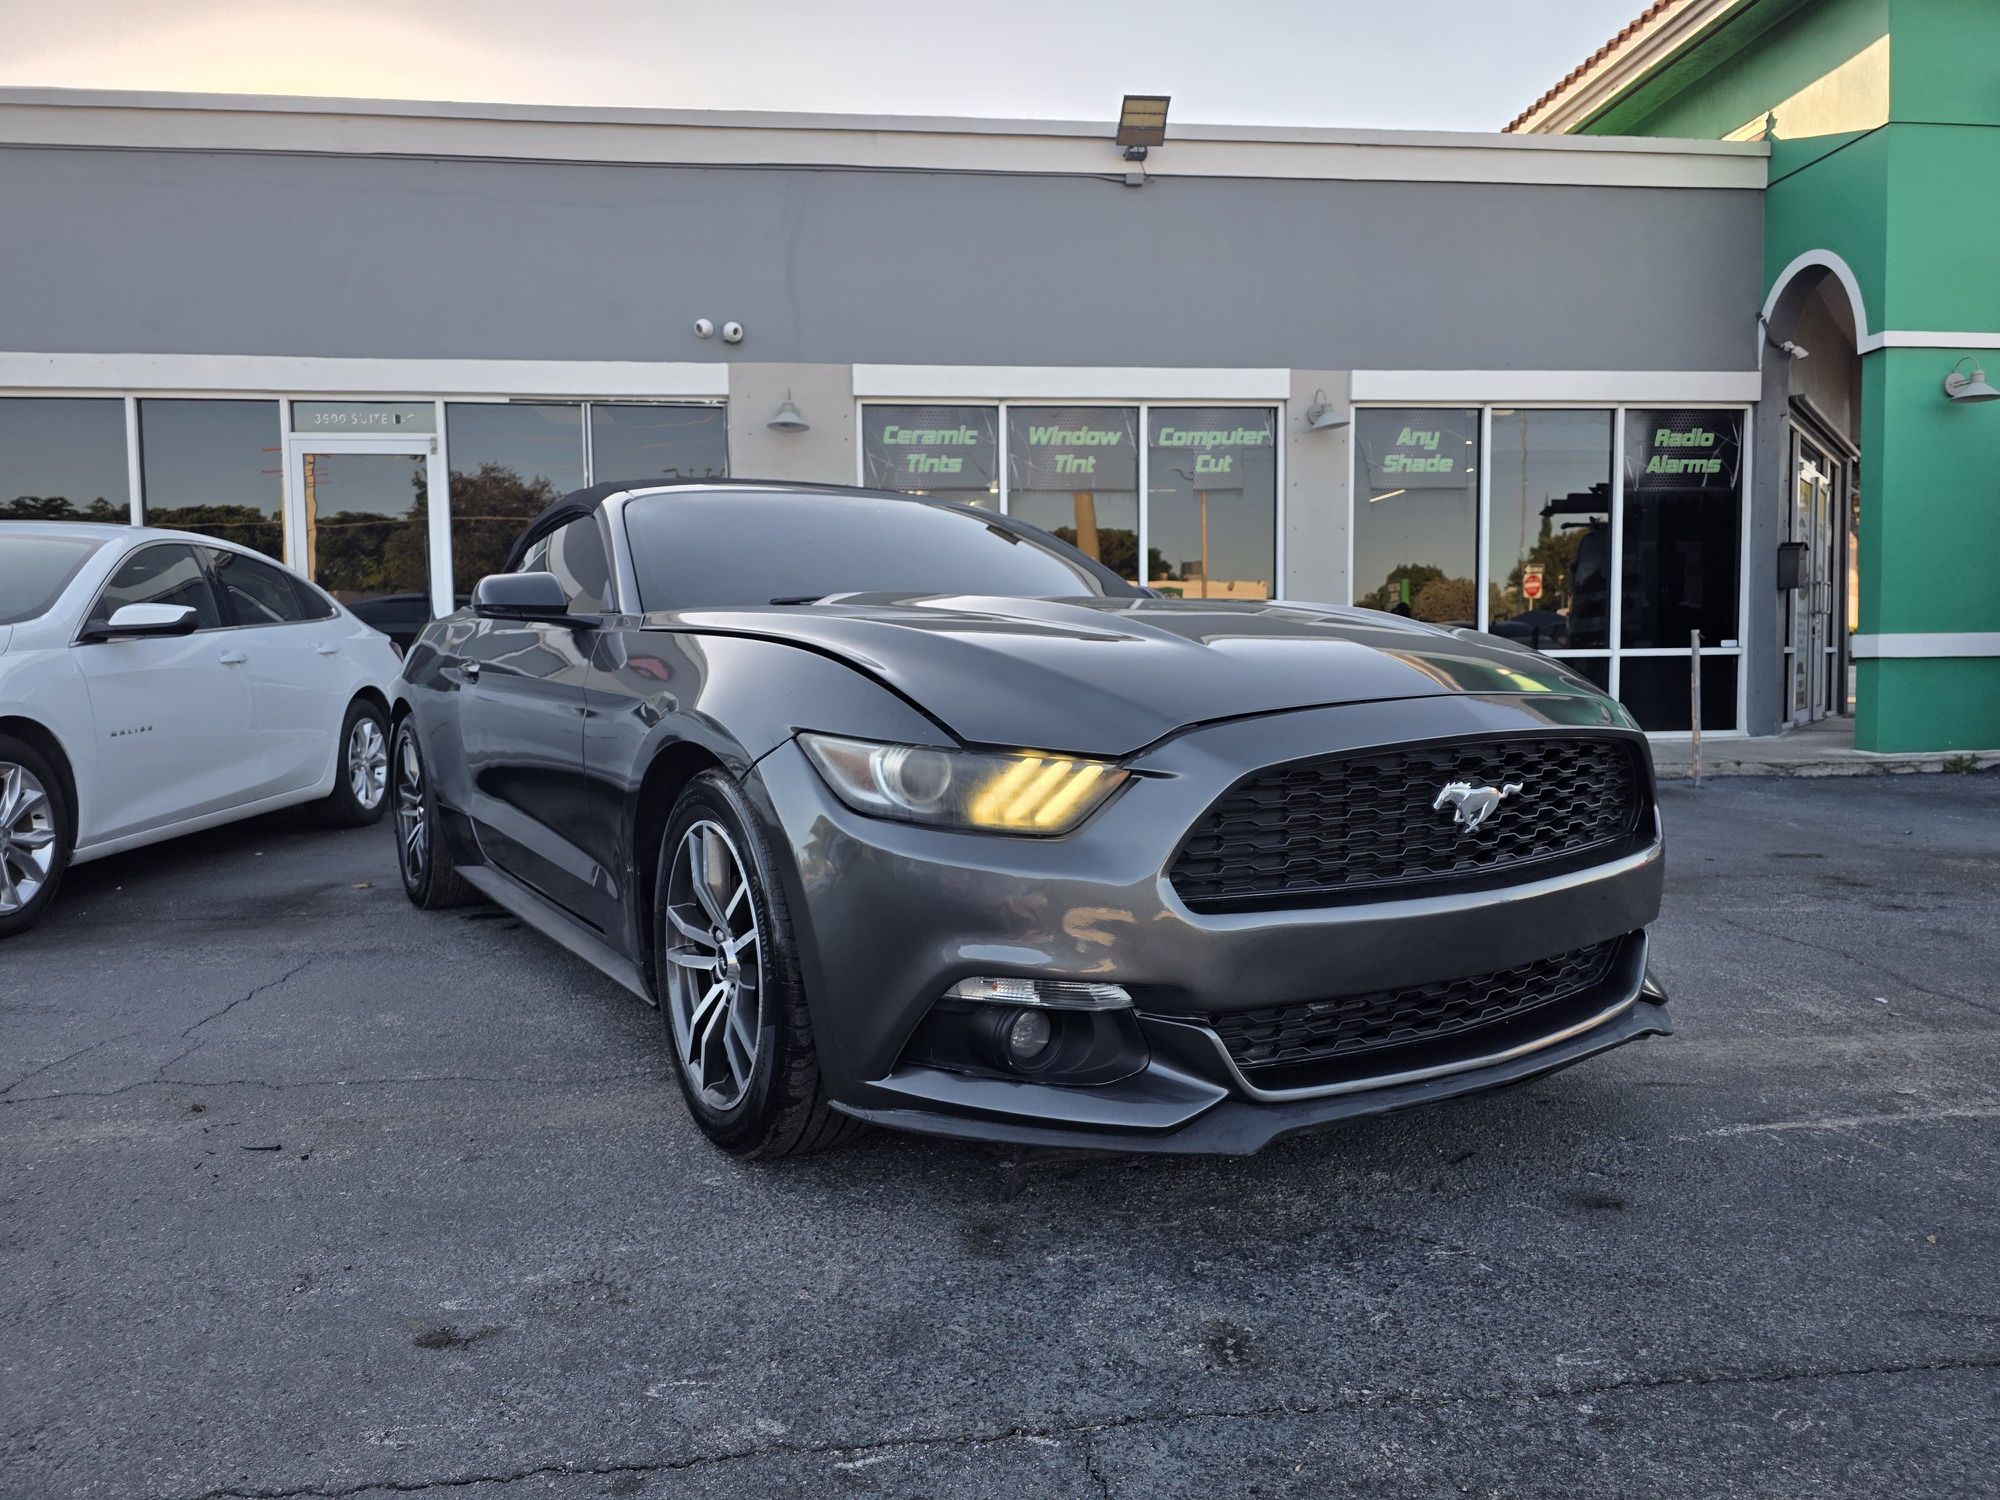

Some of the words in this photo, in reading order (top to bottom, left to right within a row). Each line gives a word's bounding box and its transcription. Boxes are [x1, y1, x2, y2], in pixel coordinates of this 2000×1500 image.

[351, 413, 388, 425] SUITE
[883, 425, 978, 446] Ceramic
[1029, 426, 1122, 446] Window
[1158, 427, 1270, 449] Computer
[1396, 427, 1441, 450] Any
[1654, 428, 1715, 448] Radio
[907, 453, 963, 474] Tints
[1054, 454, 1096, 474] Tint
[1194, 454, 1233, 473] Cut
[1382, 454, 1454, 473] Shade
[1645, 455, 1722, 474] Alarms
